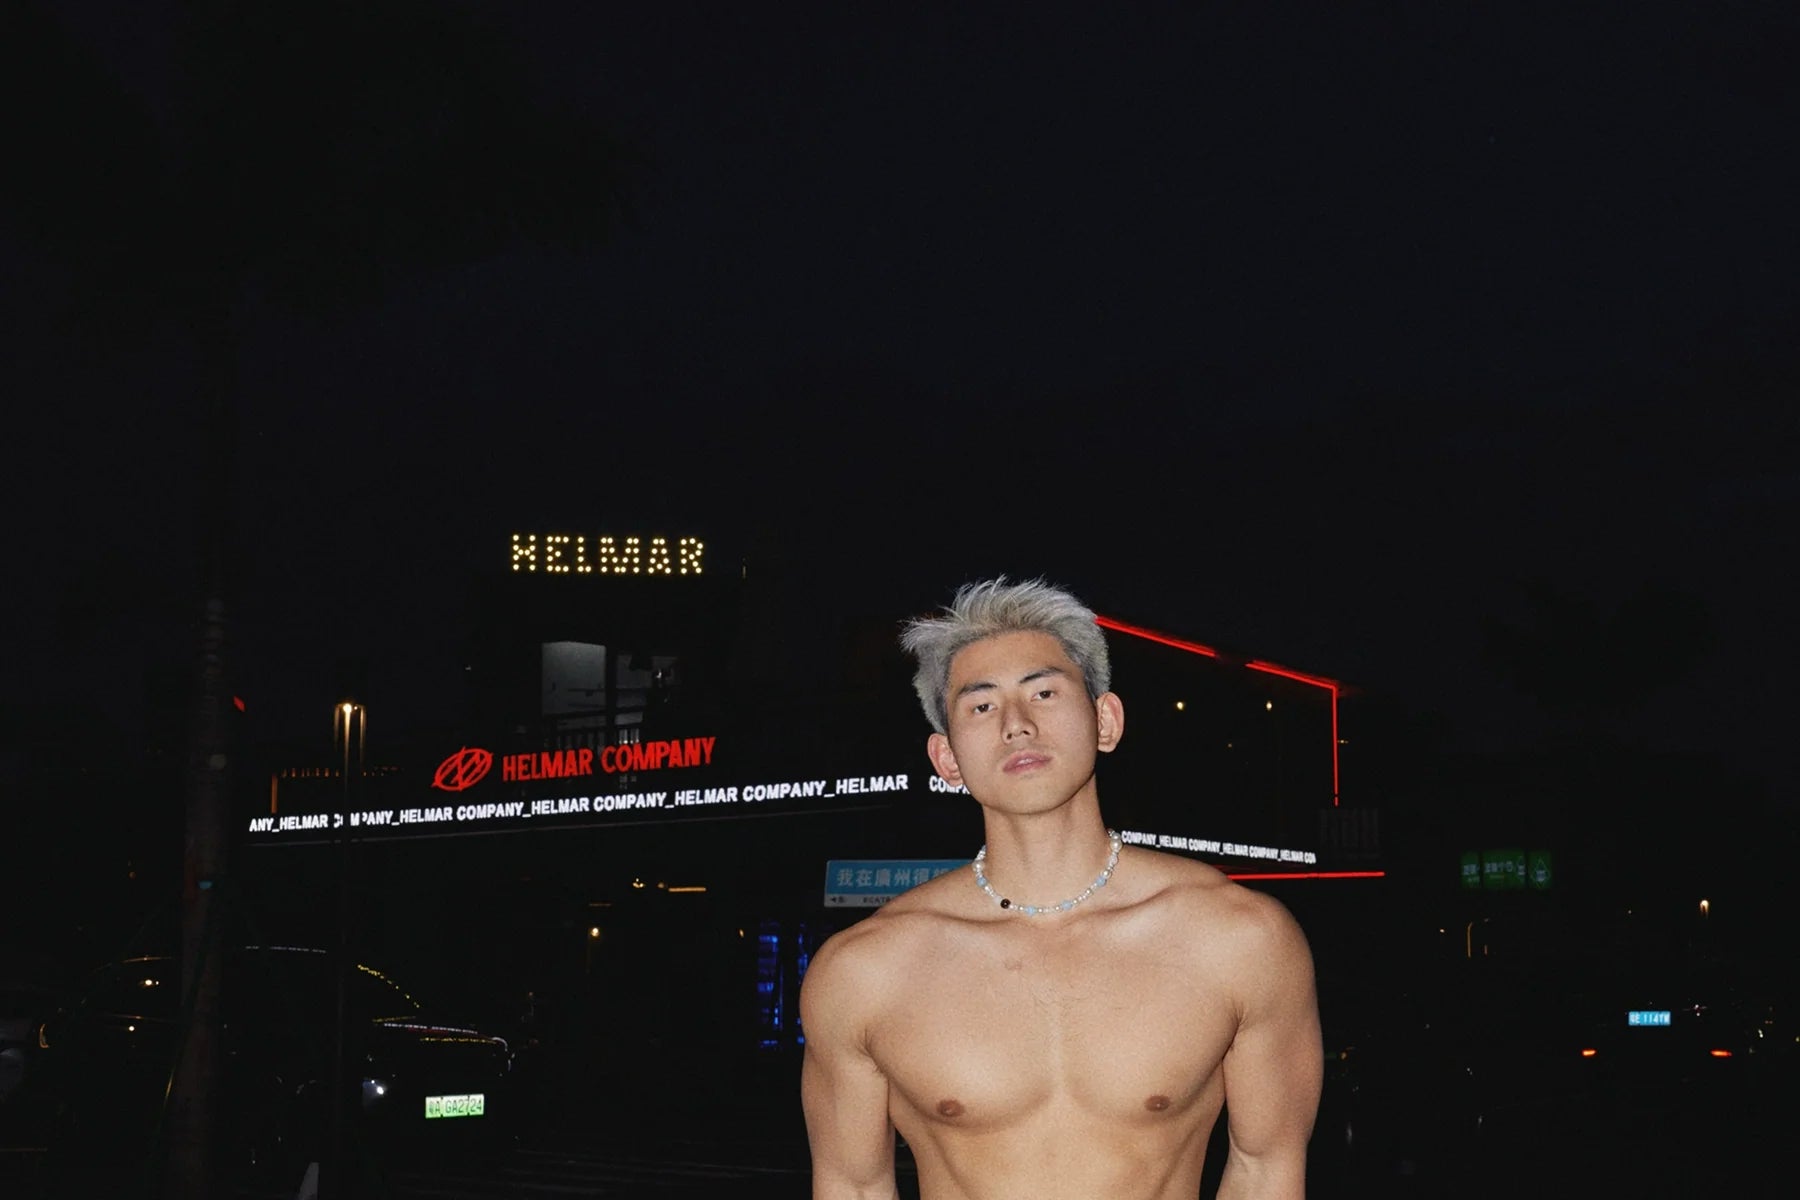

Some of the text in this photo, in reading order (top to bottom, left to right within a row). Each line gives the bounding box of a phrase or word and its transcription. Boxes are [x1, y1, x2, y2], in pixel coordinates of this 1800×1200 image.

[512, 534, 703, 574] HELMAR
[502, 736, 715, 782] HELMAR COMPANY
